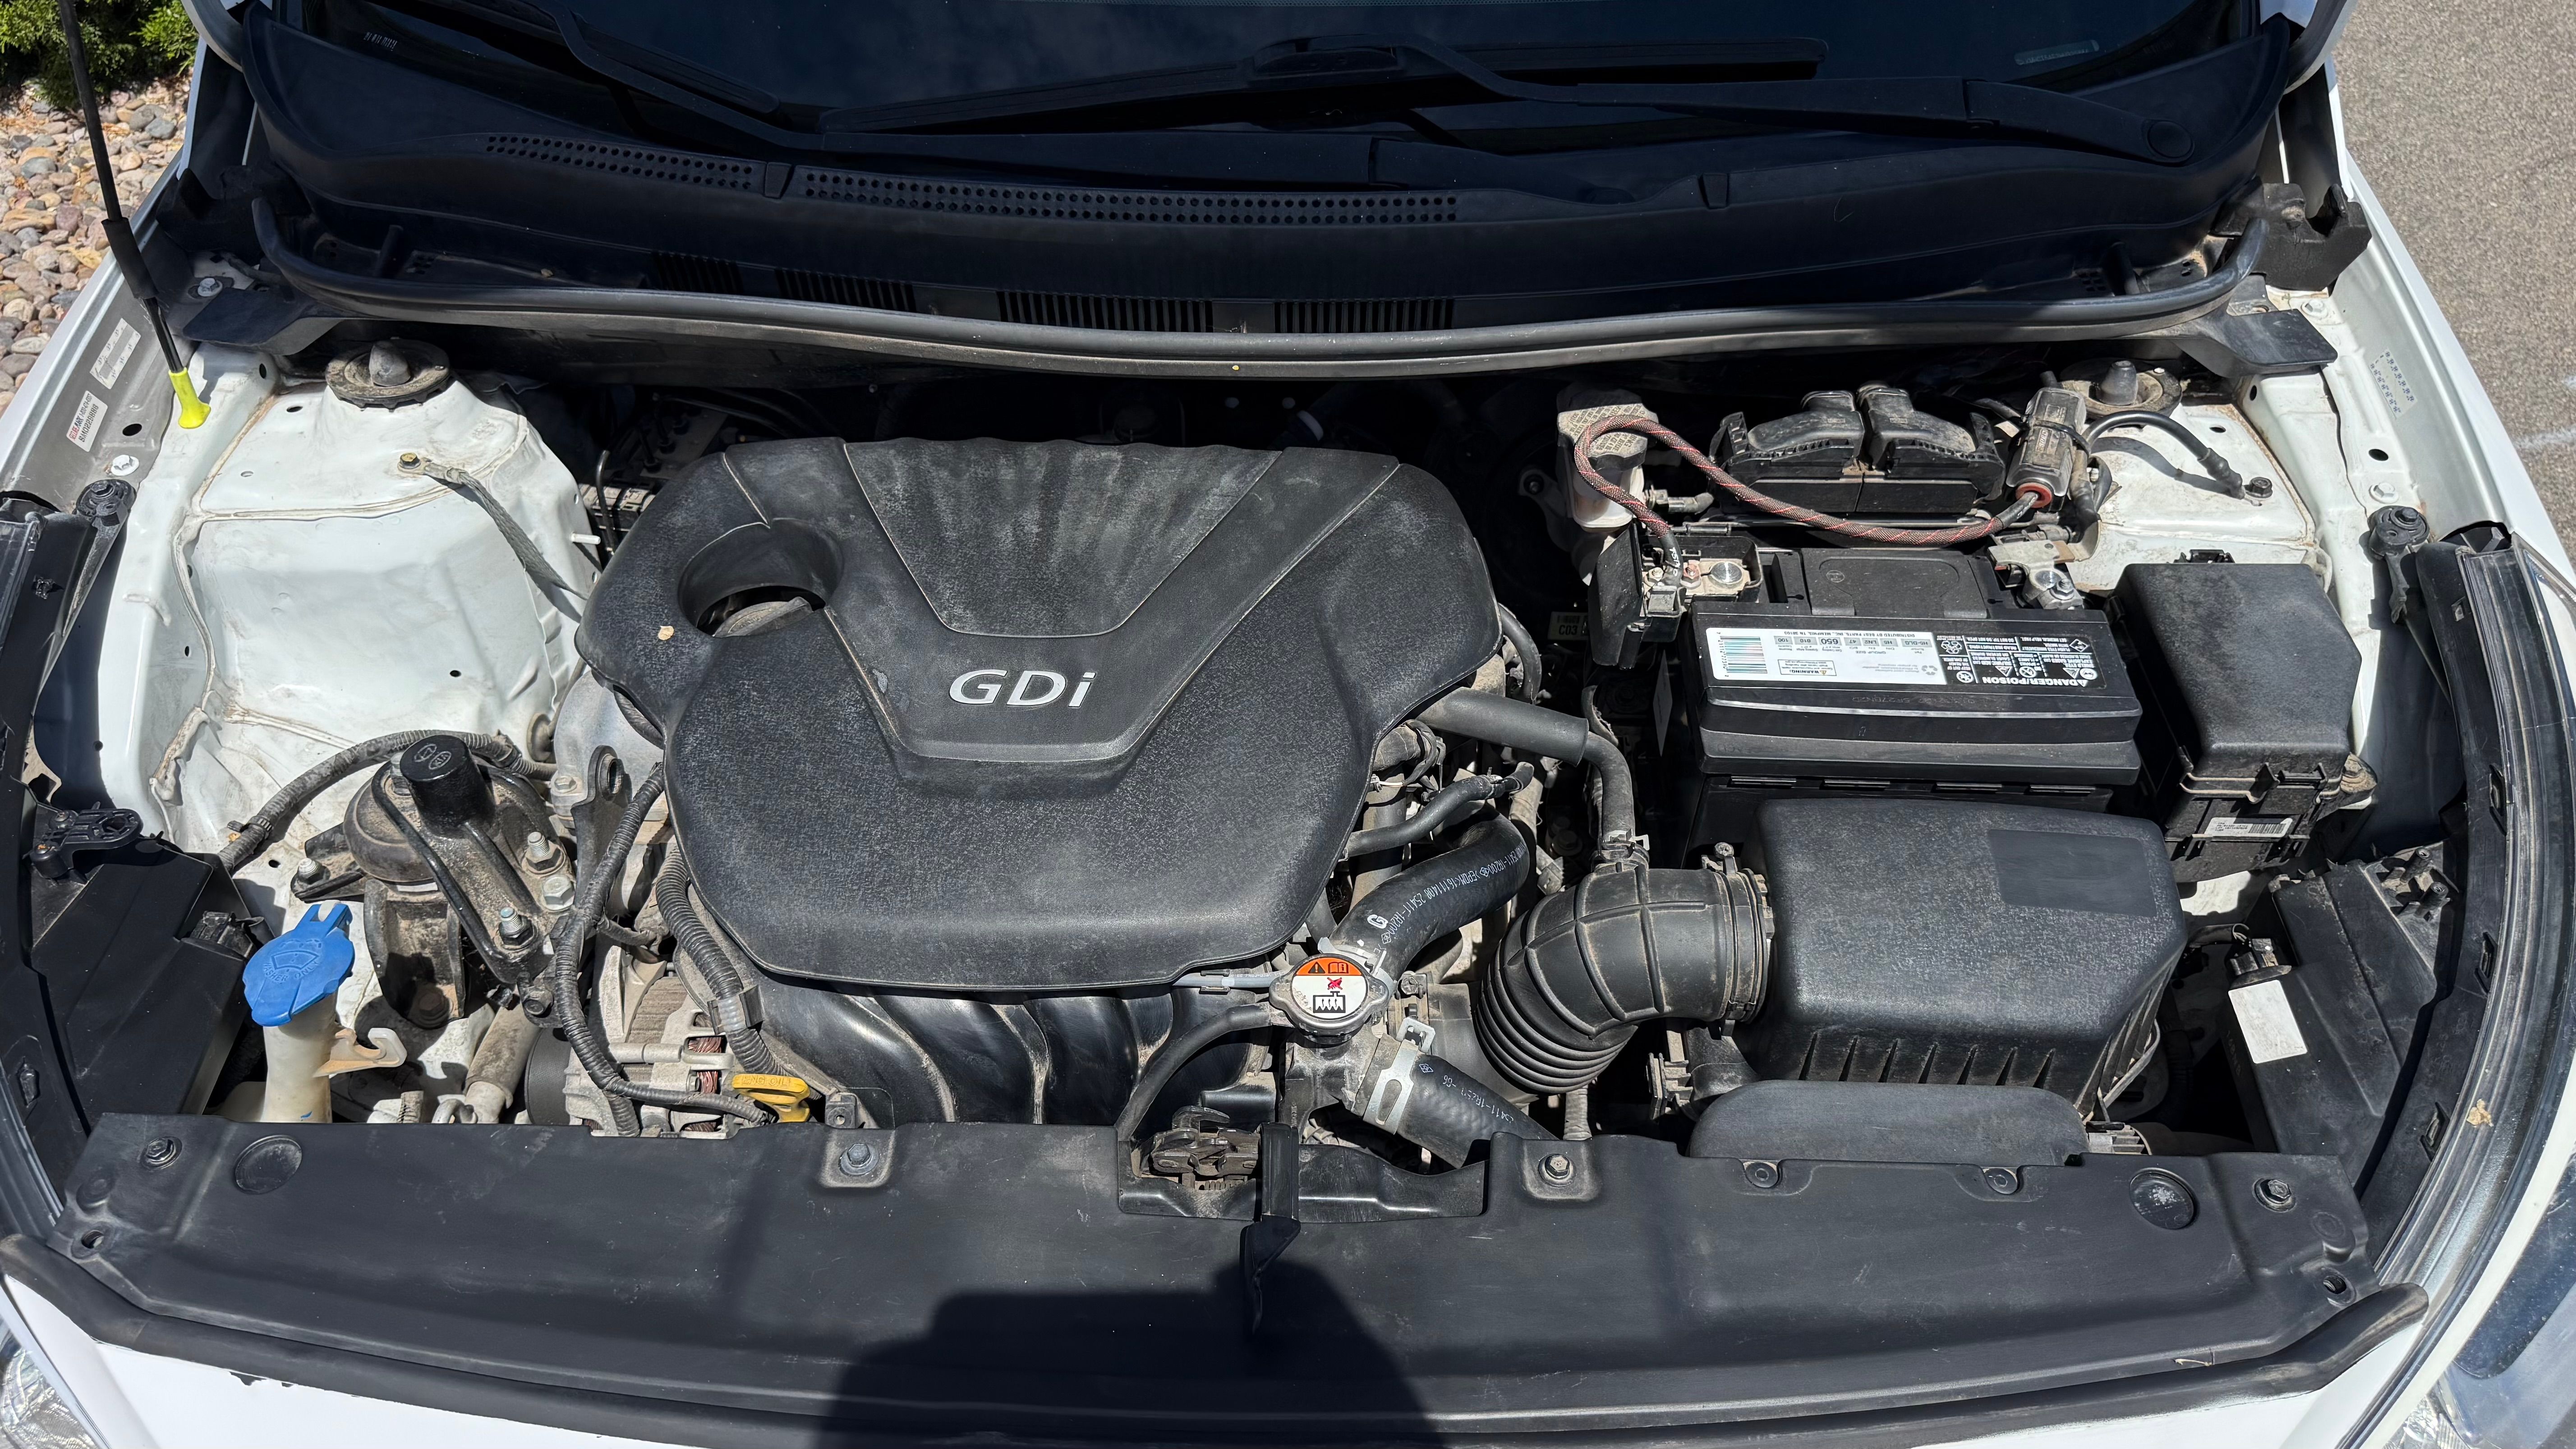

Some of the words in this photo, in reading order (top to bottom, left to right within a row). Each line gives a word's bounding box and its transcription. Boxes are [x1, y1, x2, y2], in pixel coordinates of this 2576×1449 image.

[949, 669, 1095, 707] GDi
[1982, 676, 2078, 686] DANGER/POISON
[1367, 914, 1387, 929] G
[294, 962, 319, 979] ONLY
[742, 1076, 765, 1085] ENG
[769, 1078, 787, 1086] OIL
